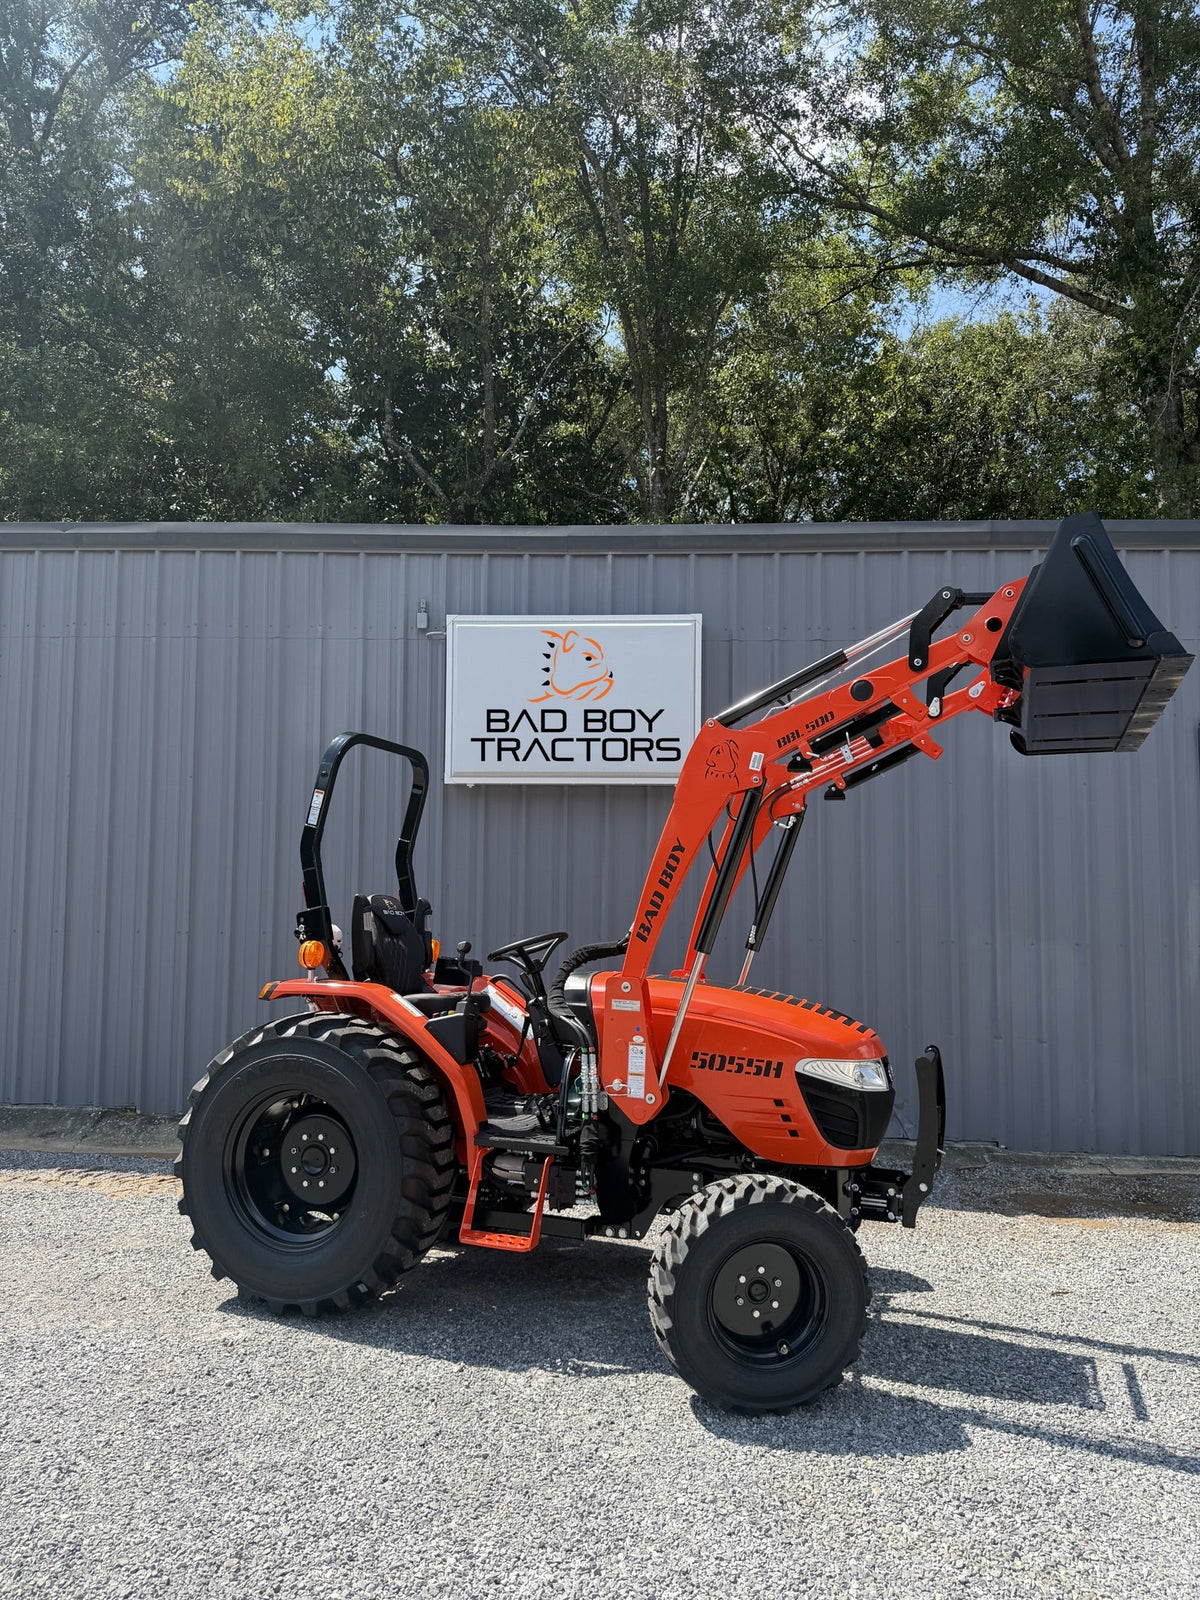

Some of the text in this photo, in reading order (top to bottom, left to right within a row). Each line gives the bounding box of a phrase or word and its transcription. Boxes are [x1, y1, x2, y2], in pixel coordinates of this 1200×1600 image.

[486, 709, 665, 733] BAD BOY
[776, 710, 835, 749] BBL 500
[470, 737, 681, 762] TRACTORS
[636, 836, 686, 943] BAD BOY
[690, 1051, 784, 1079] 5055H
